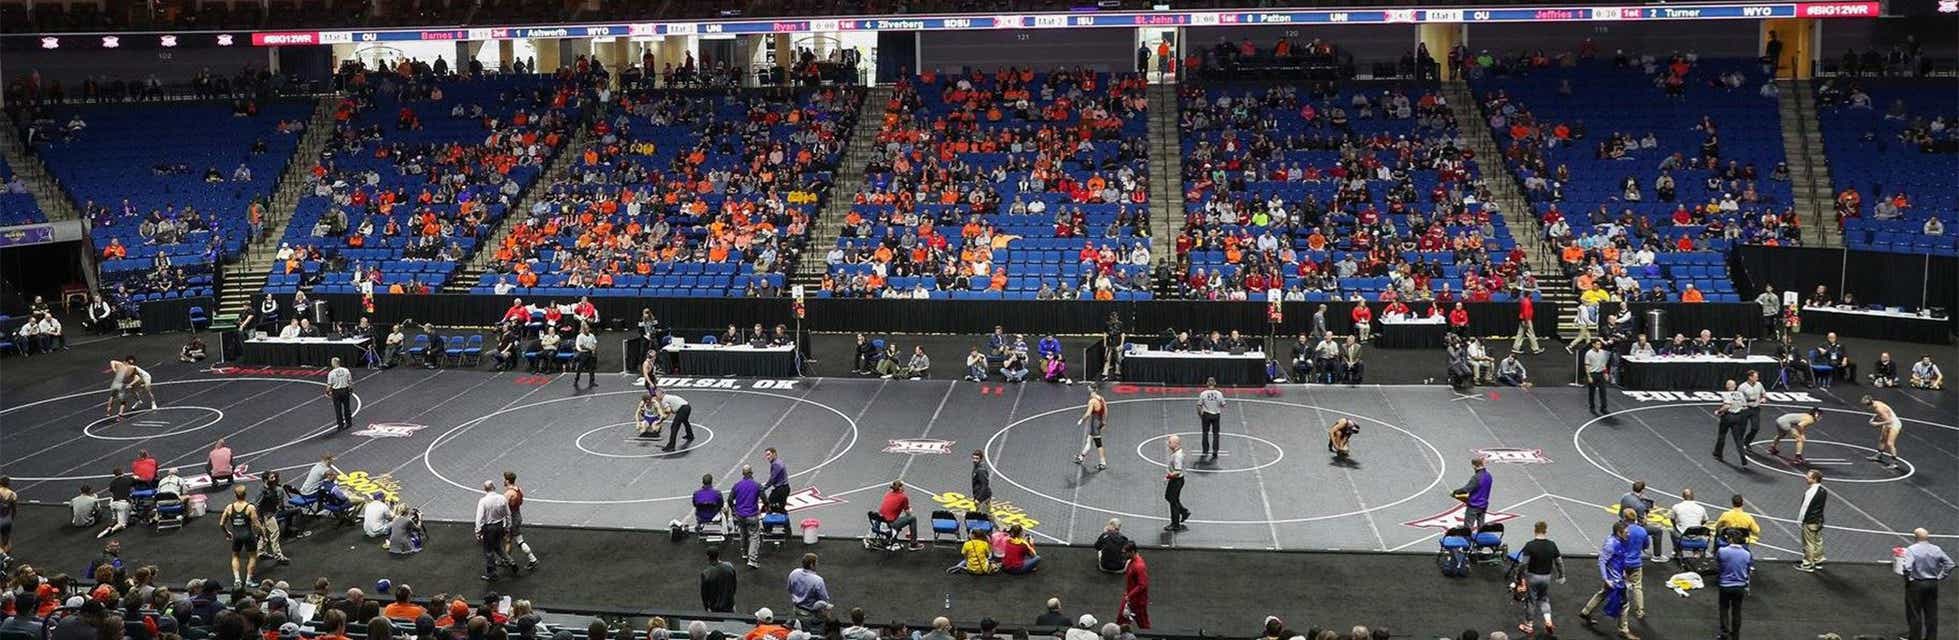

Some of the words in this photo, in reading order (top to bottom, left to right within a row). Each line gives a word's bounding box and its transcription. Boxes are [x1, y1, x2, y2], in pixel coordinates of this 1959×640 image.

[1535, 10, 1572, 19] Jeffries
[1623, 9, 1641, 18] 1st
[1650, 9, 1657, 18] 2
[1664, 8, 1699, 18] Turner
[1743, 7, 1771, 16] WYO
[1806, 5, 1868, 16] #BIG12WR
[1150, 15, 1174, 24] John
[1220, 14, 1238, 23] 1st
[1260, 13, 1291, 23] Patton
[1330, 12, 1348, 21] UNI
[1474, 11, 1489, 20] OU
[840, 21, 855, 29] 1st
[877, 20, 924, 29] Zilverberg
[943, 19, 970, 27] SDSU
[1077, 16, 1094, 25] ISU
[587, 27, 609, 36] WYO
[706, 24, 722, 33] UNI
[773, 22, 797, 33] Ryan
[362, 33, 377, 42] OU
[421, 31, 453, 40] Barnes
[527, 28, 567, 38] Ashworth
[752, 378, 800, 390] OK
[1622, 390, 1728, 402] TULS
[1765, 391, 1822, 402] OK
